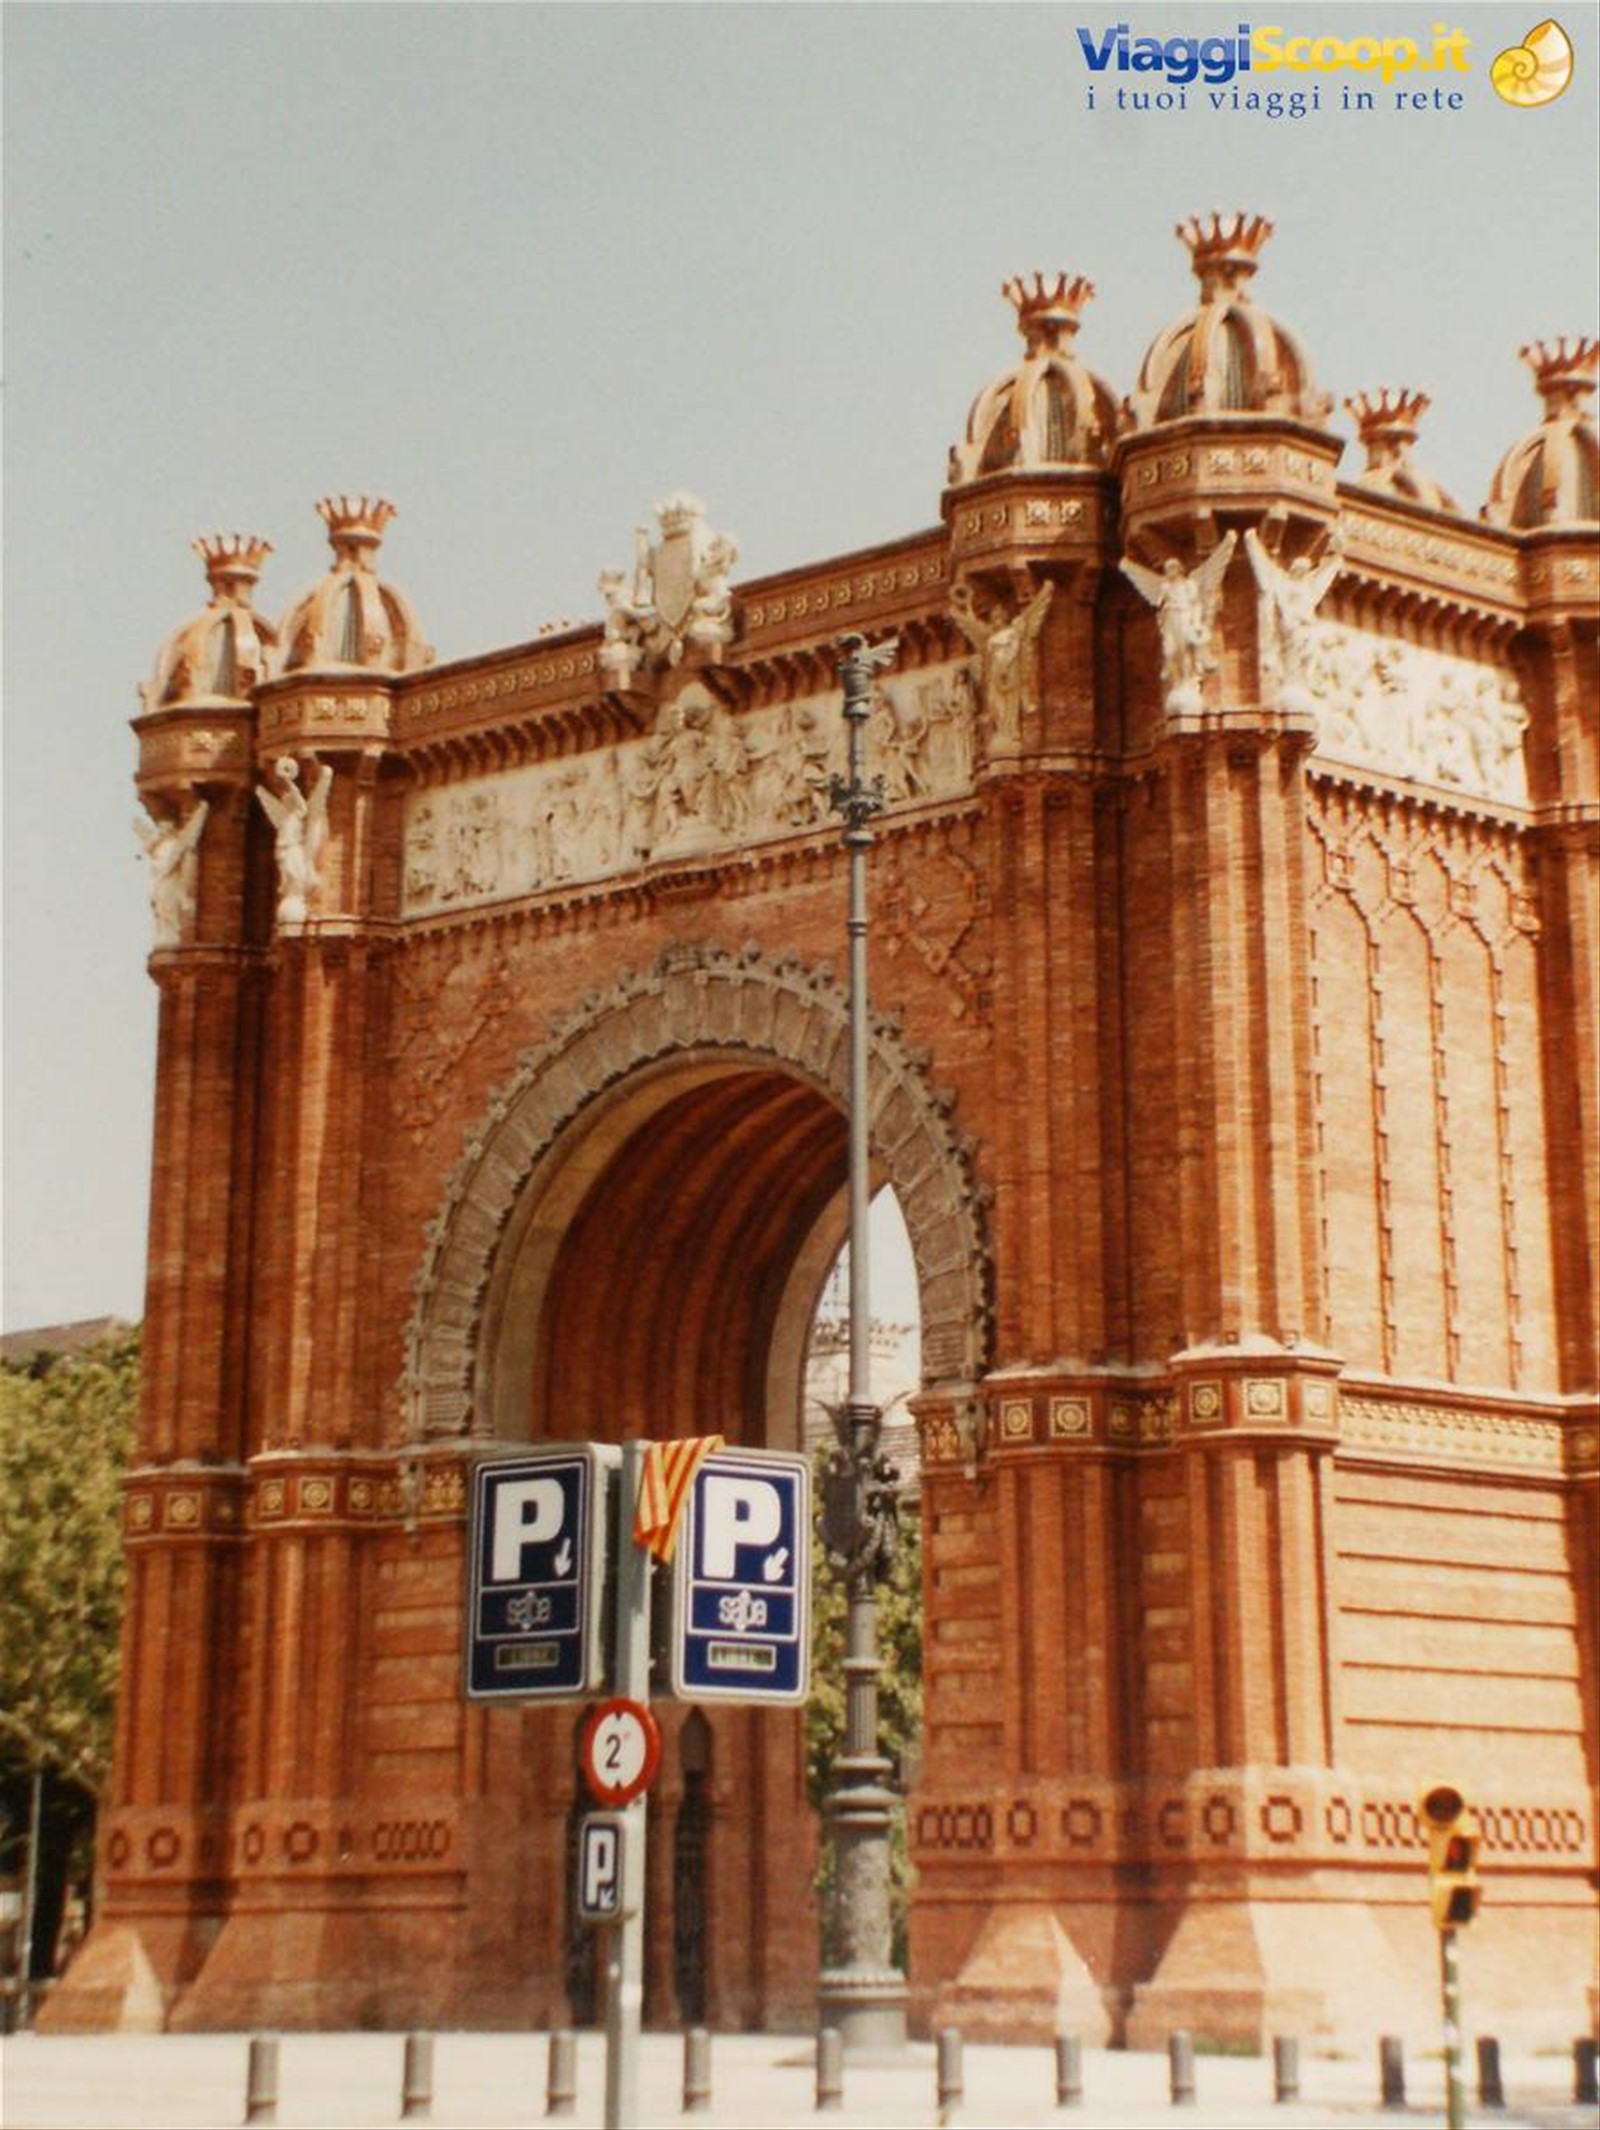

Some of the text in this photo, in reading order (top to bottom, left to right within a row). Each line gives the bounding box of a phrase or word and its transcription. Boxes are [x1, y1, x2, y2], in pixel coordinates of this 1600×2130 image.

[492, 1478, 564, 1581] P
[703, 1476, 780, 1578] P
[586, 1829, 616, 1905] P
